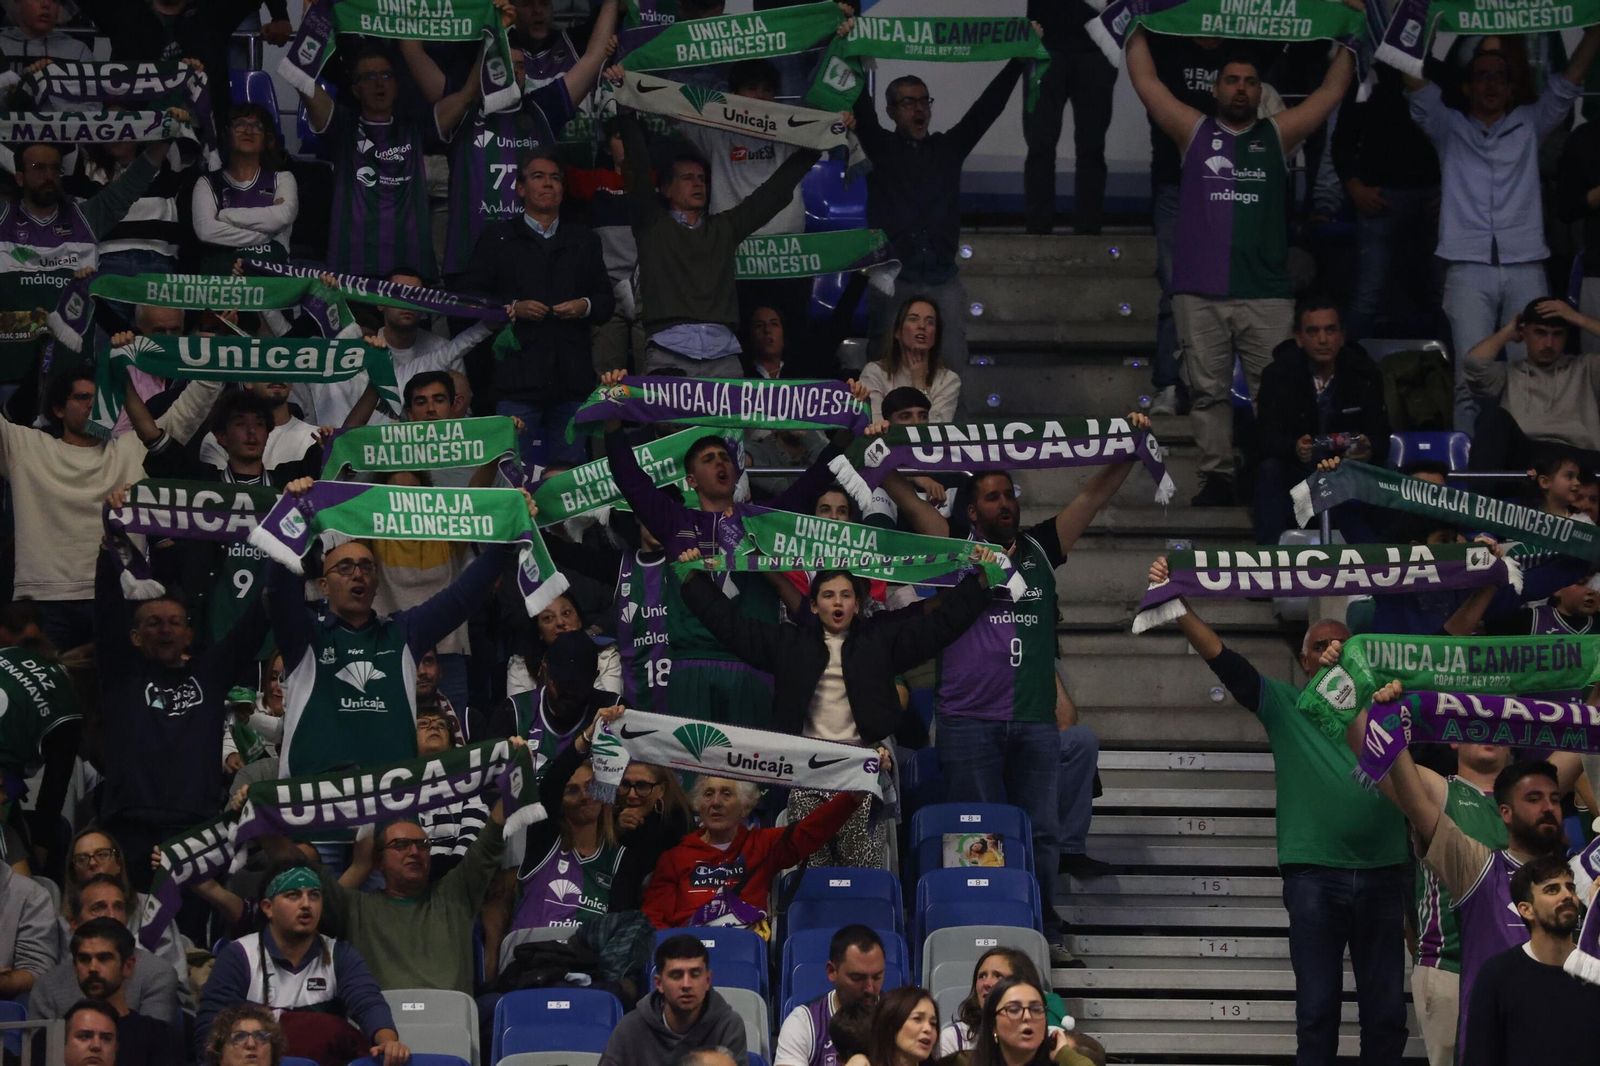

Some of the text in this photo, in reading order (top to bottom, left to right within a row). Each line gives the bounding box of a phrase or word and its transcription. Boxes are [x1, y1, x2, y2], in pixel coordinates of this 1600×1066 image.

[361, 14, 472, 36] BALONCESTO
[687, 16, 768, 42] UNICAJA
[1201, 14, 1312, 36] BALONCESTO
[1458, 5, 1574, 29] BALONCESTO
[676, 31, 787, 62] BALONCESTO
[724, 107, 777, 132] Unicaja
[11, 124, 137, 140] MALAGA
[497, 136, 539, 149] Unicaja
[1231, 167, 1267, 179] Unicaja
[735, 238, 801, 256] NICAJA
[40, 256, 78, 267] Unicaja
[146, 282, 264, 306] BALONCESTO
[178, 337, 365, 377] Unicaja
[643, 381, 863, 421] UNICAJA BALONCESTO
[381, 422, 465, 443] UNICAJA
[905, 417, 1136, 464] UNICAJA
[364, 440, 484, 465] BALONCESTO
[388, 491, 474, 514] UNICAJA
[1401, 478, 1469, 515] UNICAJA
[1475, 495, 1574, 542] BALONCESTO
[372, 513, 494, 536] BALONCESTO
[795, 515, 878, 550] UNICAJA
[758, 556, 825, 568] UNICAJA
[1194, 544, 1442, 591] UNICAJA
[232, 569, 254, 599] 9
[1010, 637, 1022, 667] 9
[1365, 638, 1582, 674] UNICAJA CAMPEÓN
[644, 658, 672, 688] 18
[341, 696, 386, 711] Unicaja
[727, 752, 794, 776] Unicaja
[1177, 756, 1196, 766] 17
[276, 741, 511, 826] UNICAJA
[1187, 821, 1206, 831] 16
[1201, 881, 1221, 891] 15
[1209, 942, 1228, 952] 14
[1220, 1005, 1241, 1016] 13
